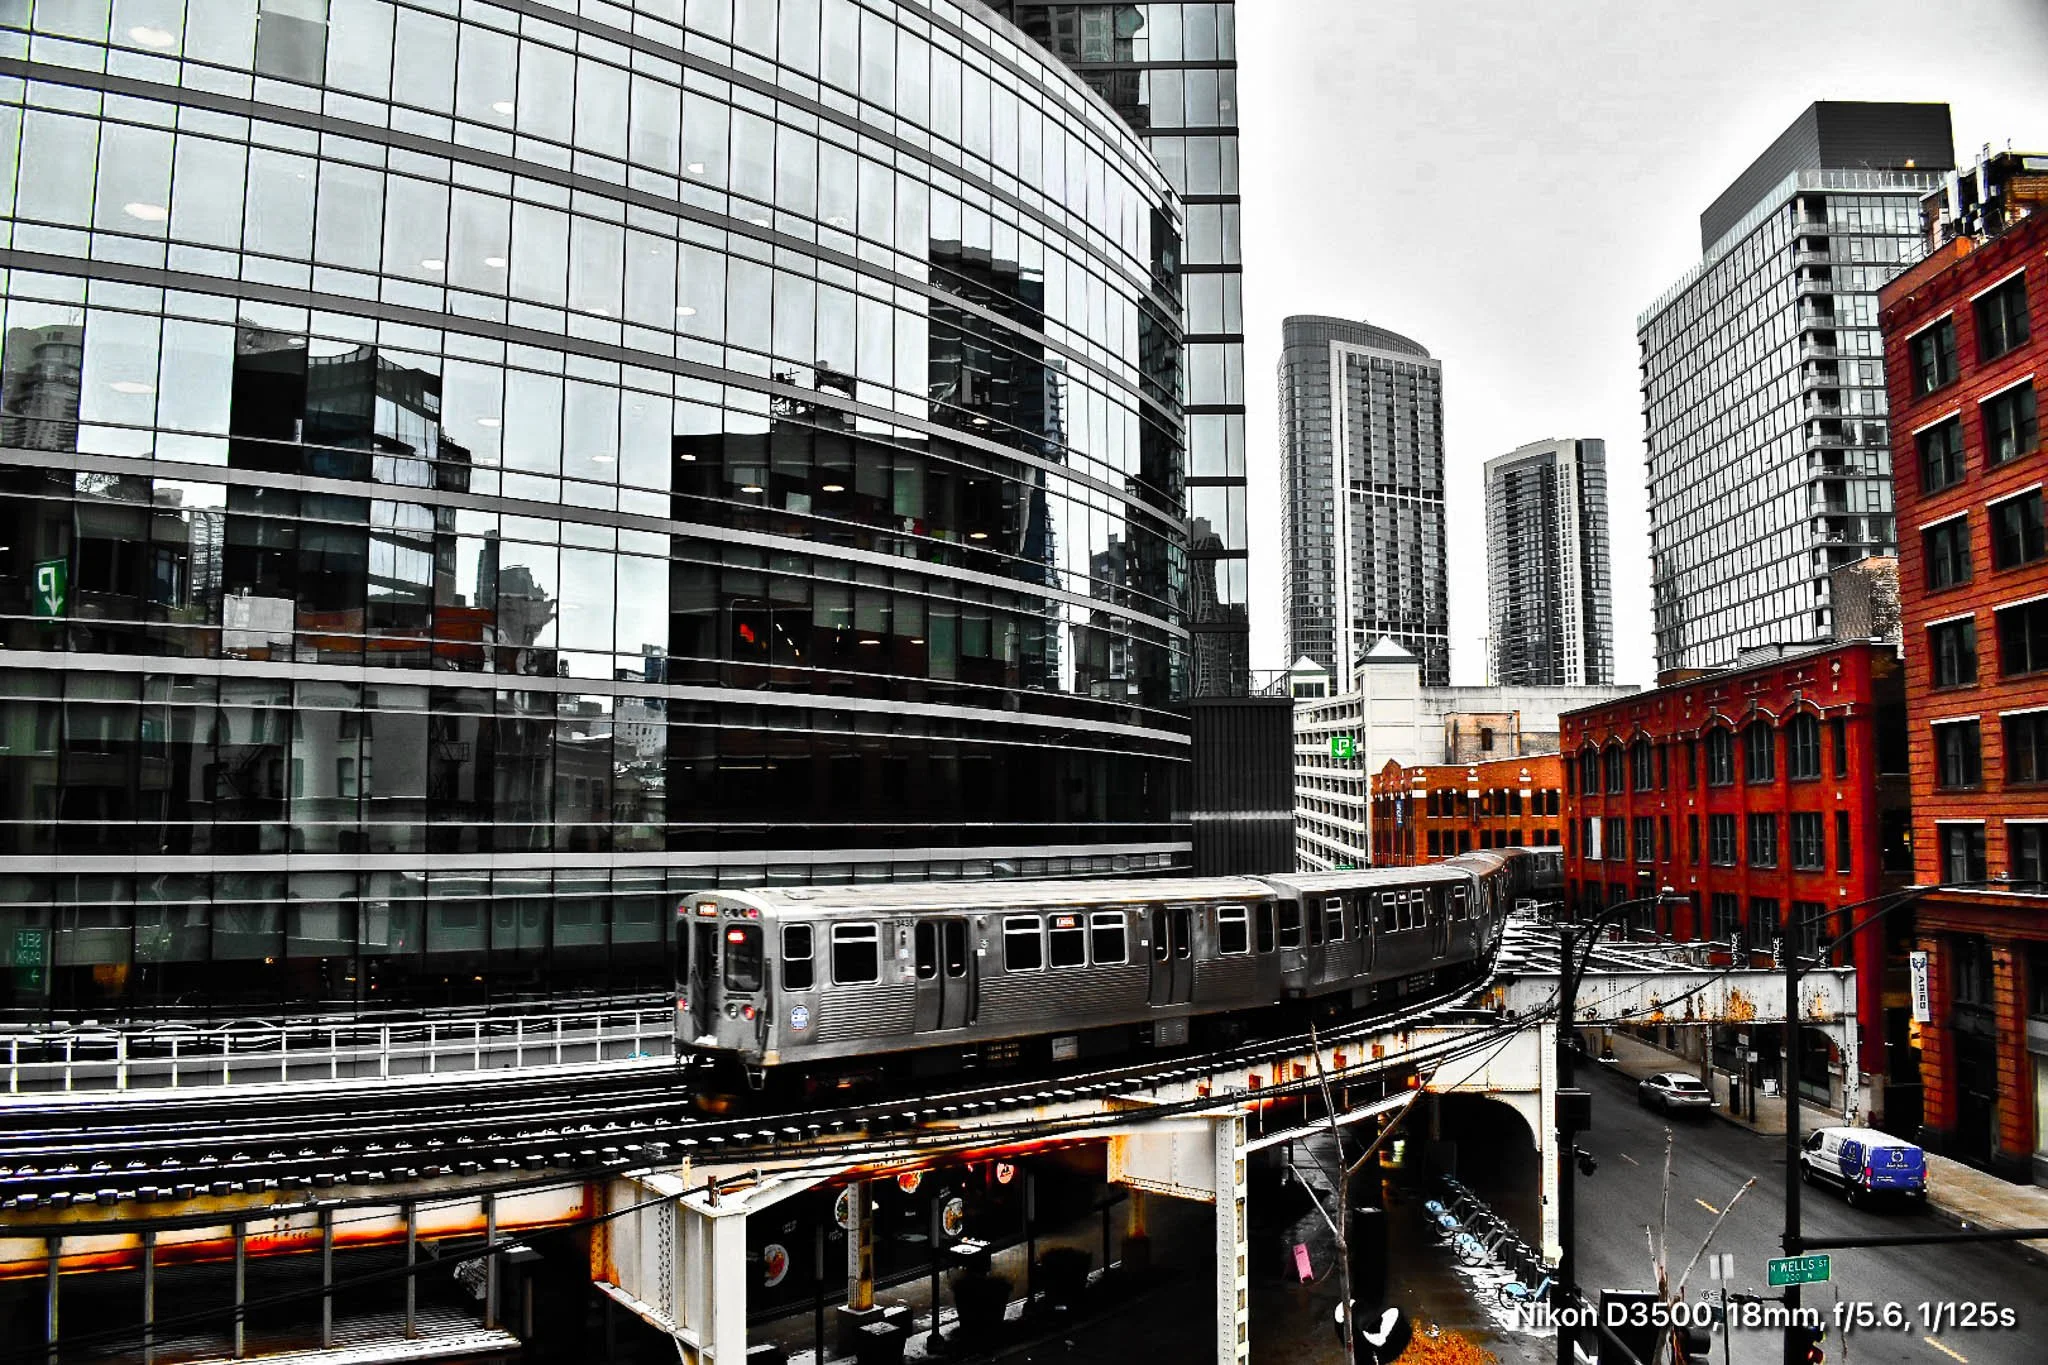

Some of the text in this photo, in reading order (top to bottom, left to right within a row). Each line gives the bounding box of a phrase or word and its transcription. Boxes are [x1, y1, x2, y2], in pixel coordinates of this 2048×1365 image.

[1770, 1259, 1828, 1273] N WELLS ST
